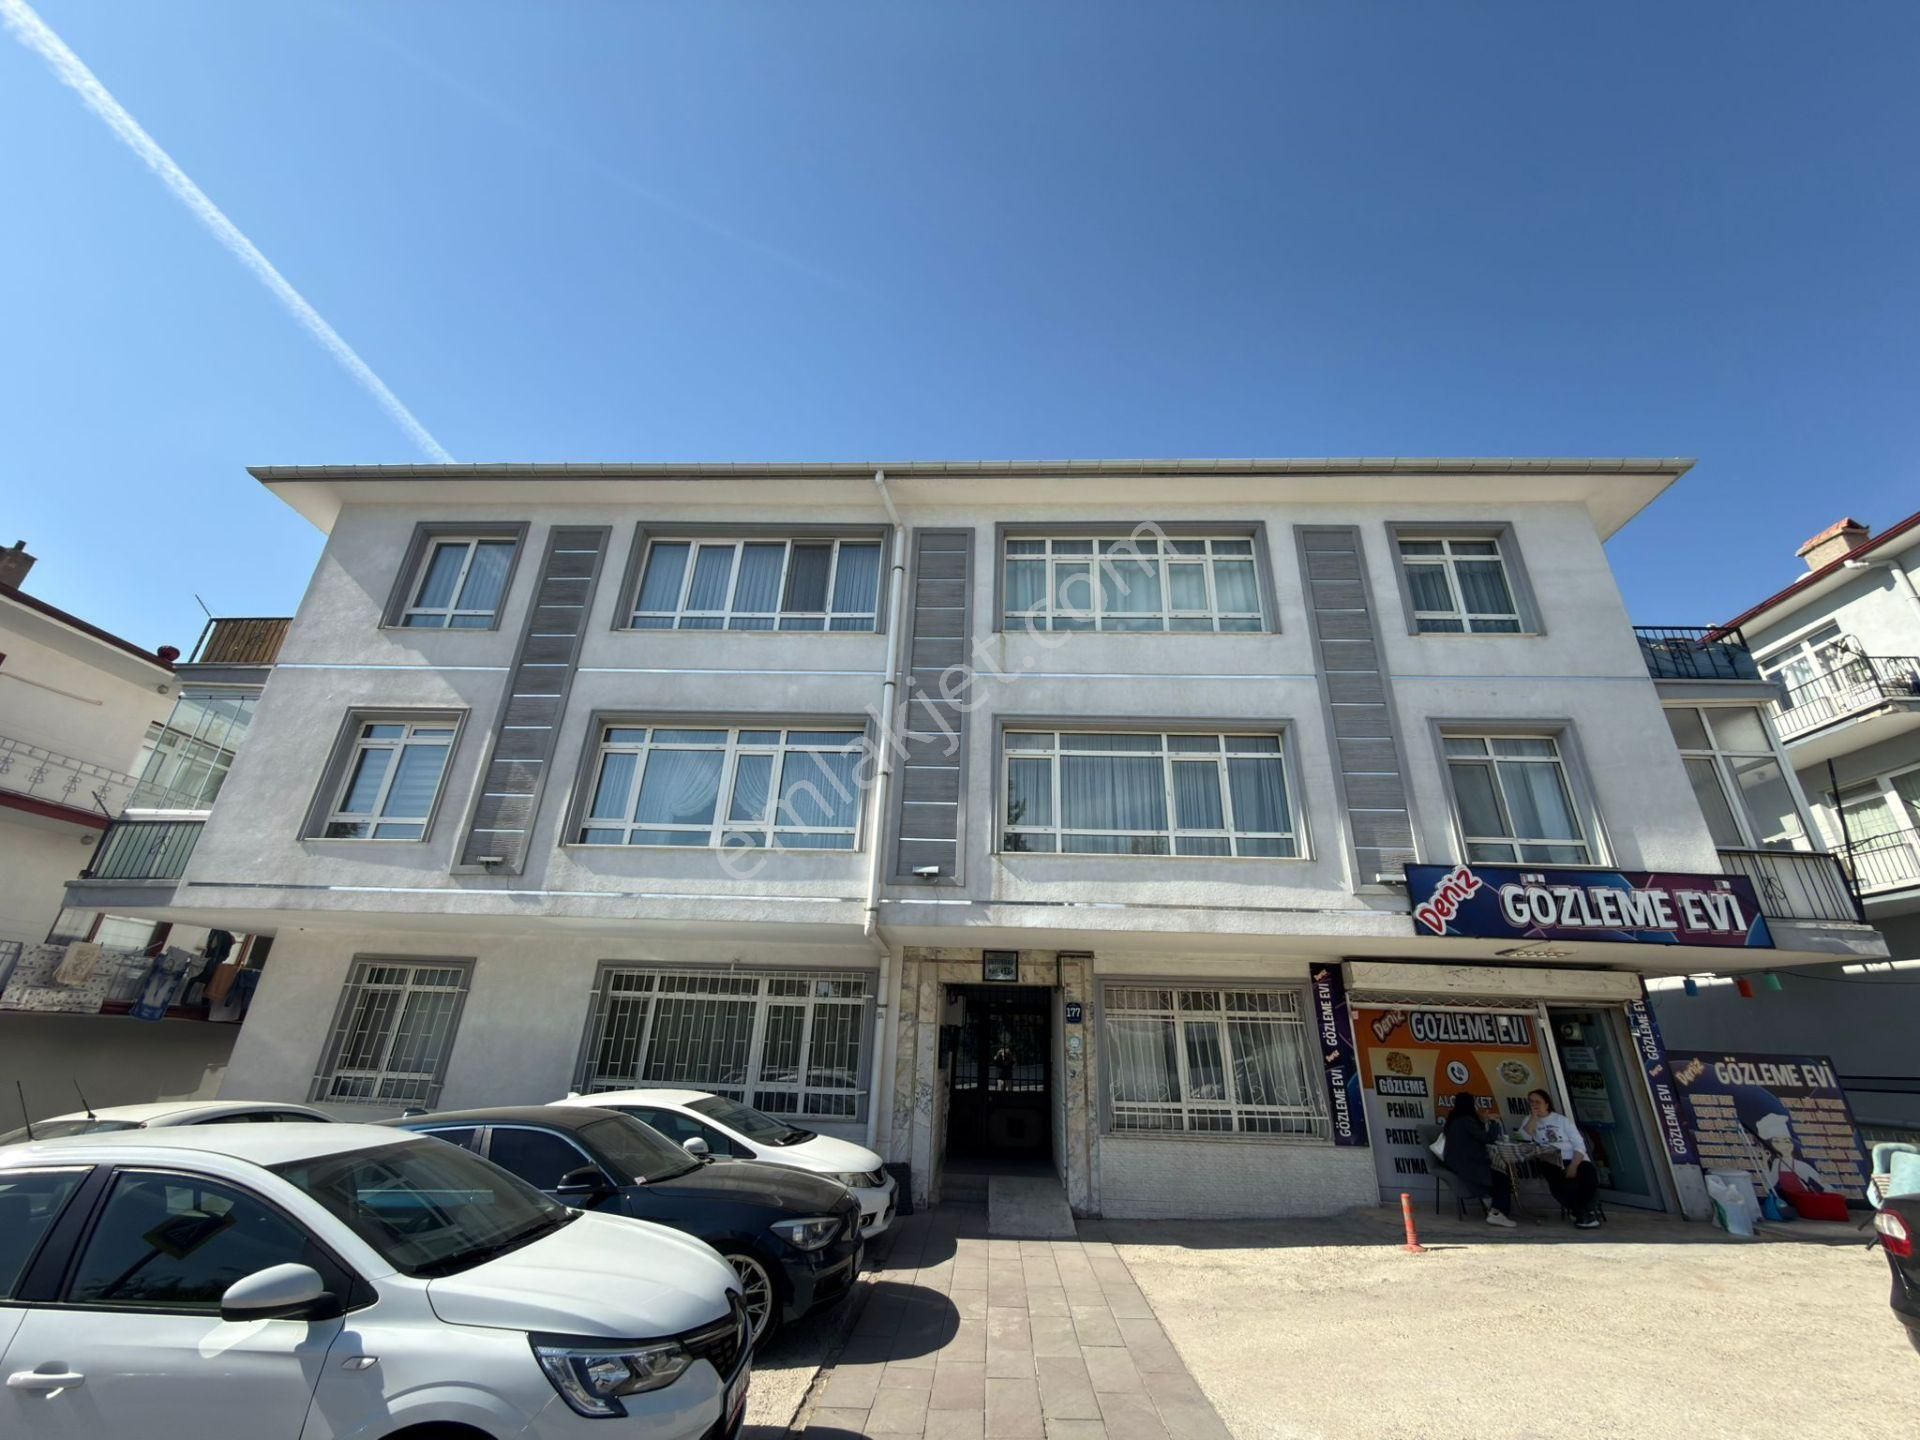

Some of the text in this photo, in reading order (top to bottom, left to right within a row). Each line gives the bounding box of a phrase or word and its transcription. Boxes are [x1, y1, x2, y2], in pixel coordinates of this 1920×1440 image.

[1416, 866, 1482, 935] Deniz
[1500, 872, 1748, 932] GÖZLEME EVİ
[1066, 1007, 1081, 1018] 177
[1321, 1001, 1338, 1046] GÖZLEME
[1378, 1077, 1427, 1095] GÖZLEME
[1714, 1056, 1837, 1089] GÖZLEME EVİ
[1333, 1086, 1351, 1137] GÖZLEME
[1662, 1102, 1687, 1154] GÖZLEME
[1385, 1128, 1420, 1145] PATATE
